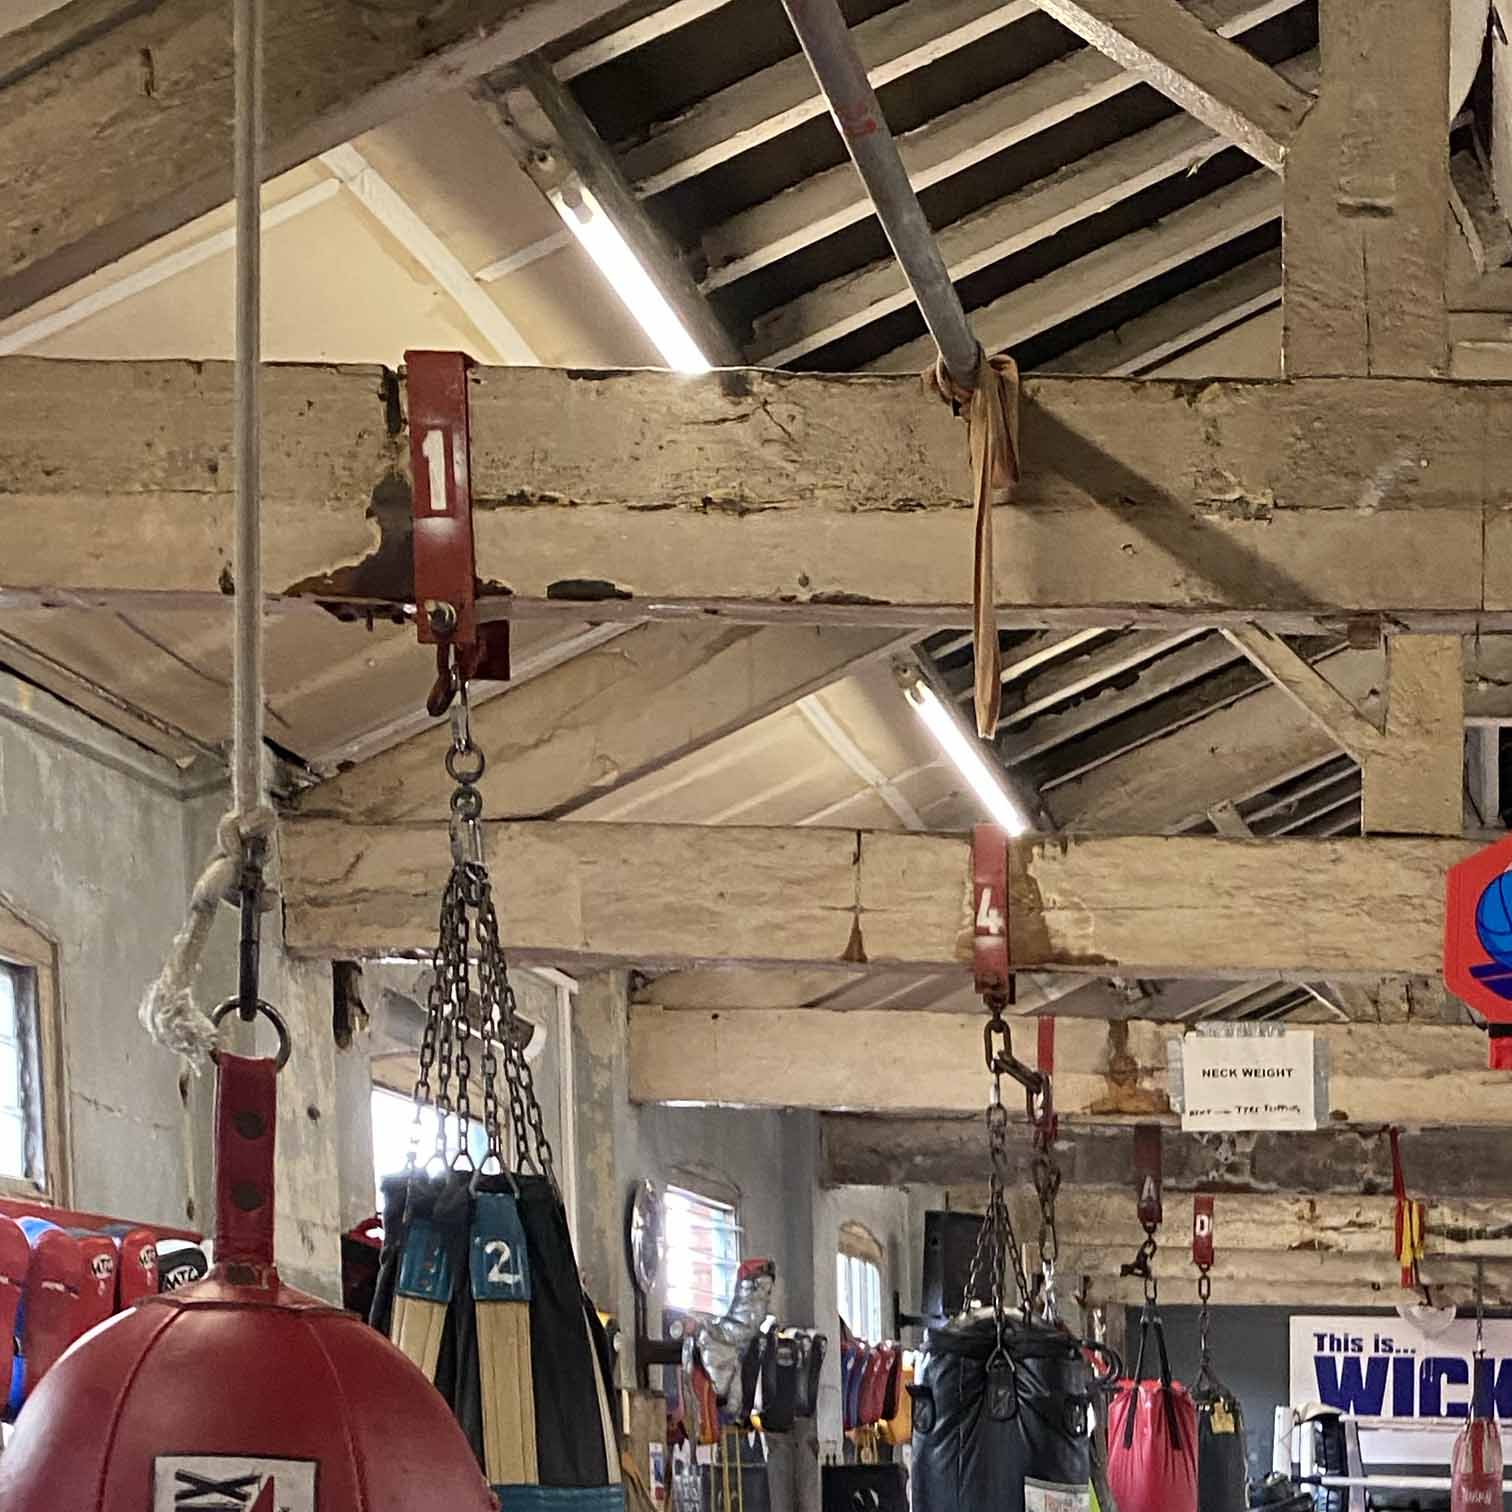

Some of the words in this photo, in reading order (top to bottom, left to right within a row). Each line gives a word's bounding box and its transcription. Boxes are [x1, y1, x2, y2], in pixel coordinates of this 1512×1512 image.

[422, 429, 447, 511] 1
[976, 887, 1004, 934] 4
[1202, 1068, 1238, 1079] NECK
[1242, 1068, 1294, 1078] WEIGHT
[1195, 1214, 1209, 1236] D
[485, 1240, 521, 1285] 2
[1313, 1332, 1364, 1353] This
[1374, 1333, 1417, 1354] is...
